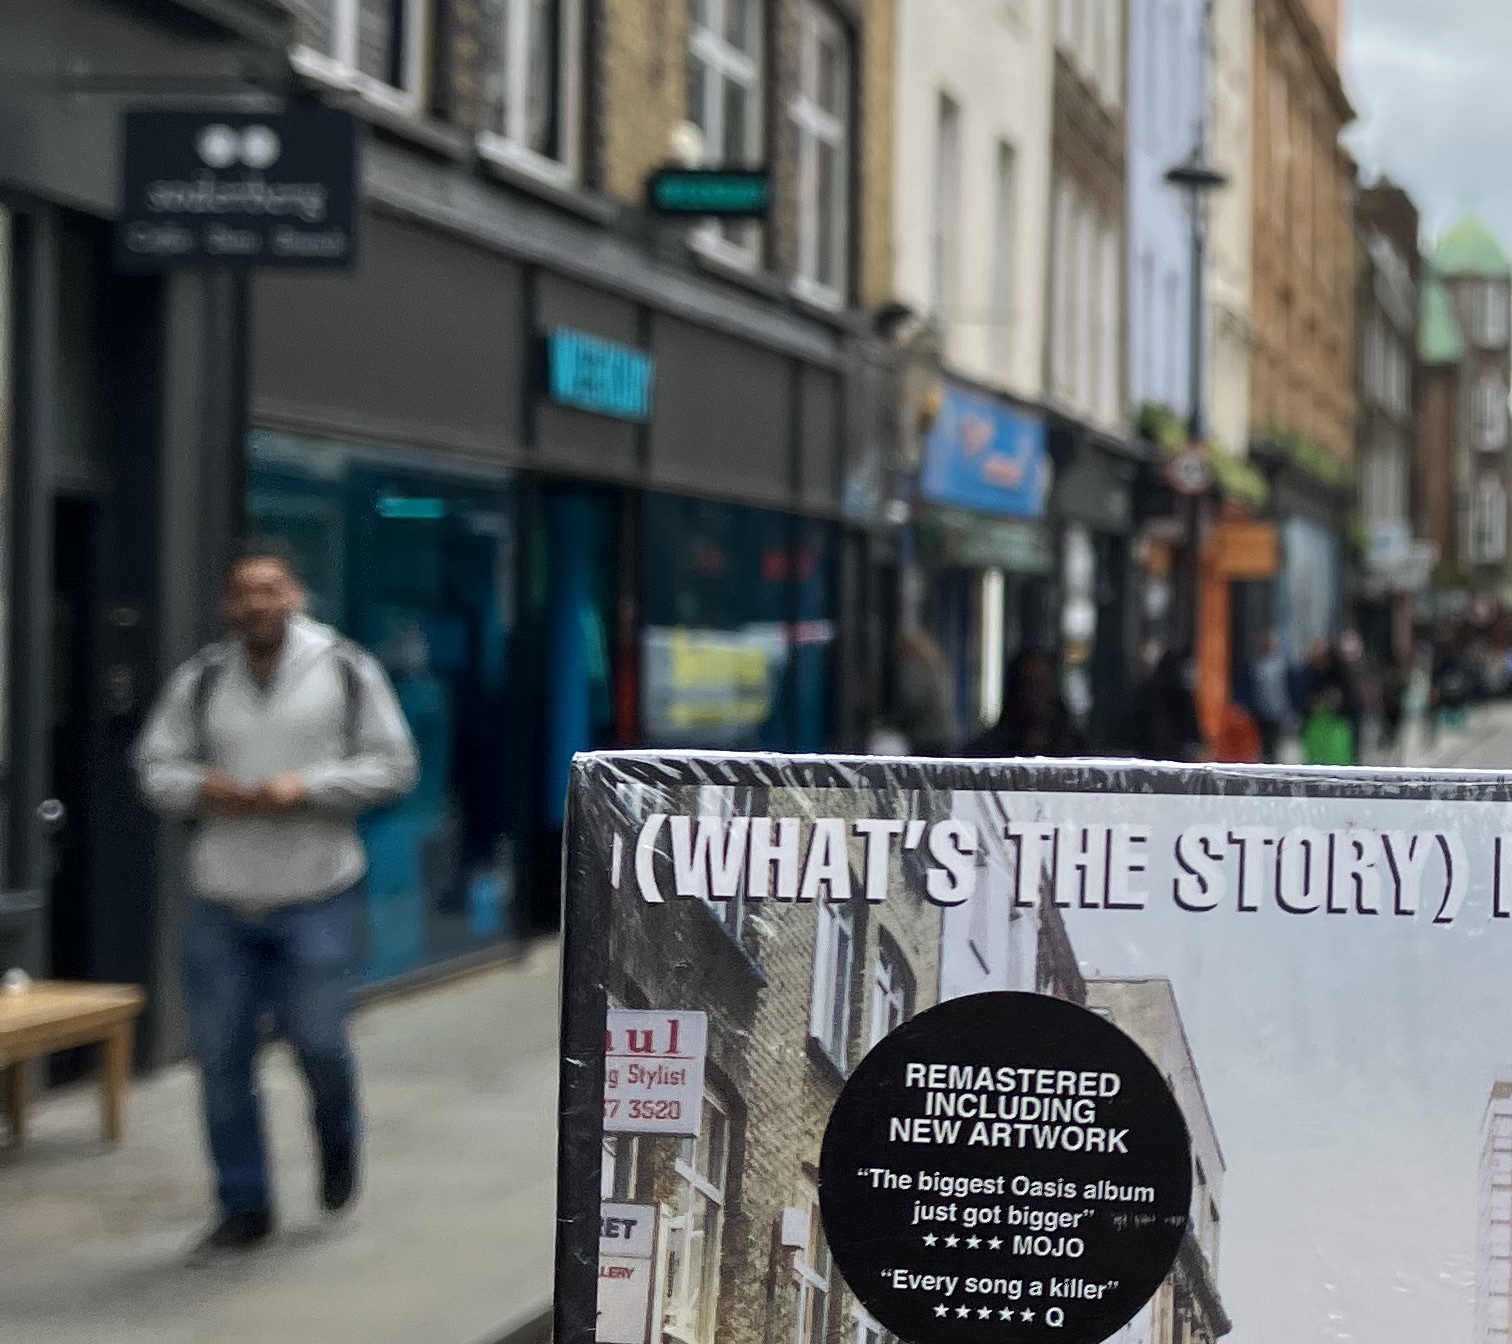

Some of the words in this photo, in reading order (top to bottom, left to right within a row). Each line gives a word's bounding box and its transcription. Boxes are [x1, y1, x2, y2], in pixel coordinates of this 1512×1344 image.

[634, 813, 976, 908] (WHAT'S
[1005, 819, 1148, 910] THE
[1173, 824, 1468, 923] STORY)
[628, 1063, 686, 1090] Stylist
[905, 1063, 1121, 1097] REMASTERED
[925, 1092, 1096, 1123] INCLUDING
[889, 1118, 961, 1144] NEW
[968, 1123, 1129, 1154] ARTWORK
[857, 1168, 912, 1191] “The
[919, 1172, 1004, 1197] biggest
[1012, 1175, 1077, 1199] Oasis
[1083, 1181, 1155, 1203] album
[911, 1201, 957, 1225] just
[963, 1205, 1002, 1226] got
[1008, 1206, 1095, 1231] bigger”
[1013, 1235, 1084, 1257] MOJO
[881, 1269, 958, 1295] “Every
[965, 1278, 1022, 1300] song
[1029, 1282, 1042, 1296] a
[1050, 1278, 1119, 1299] killer”
[1046, 1307, 1064, 1327] Q
